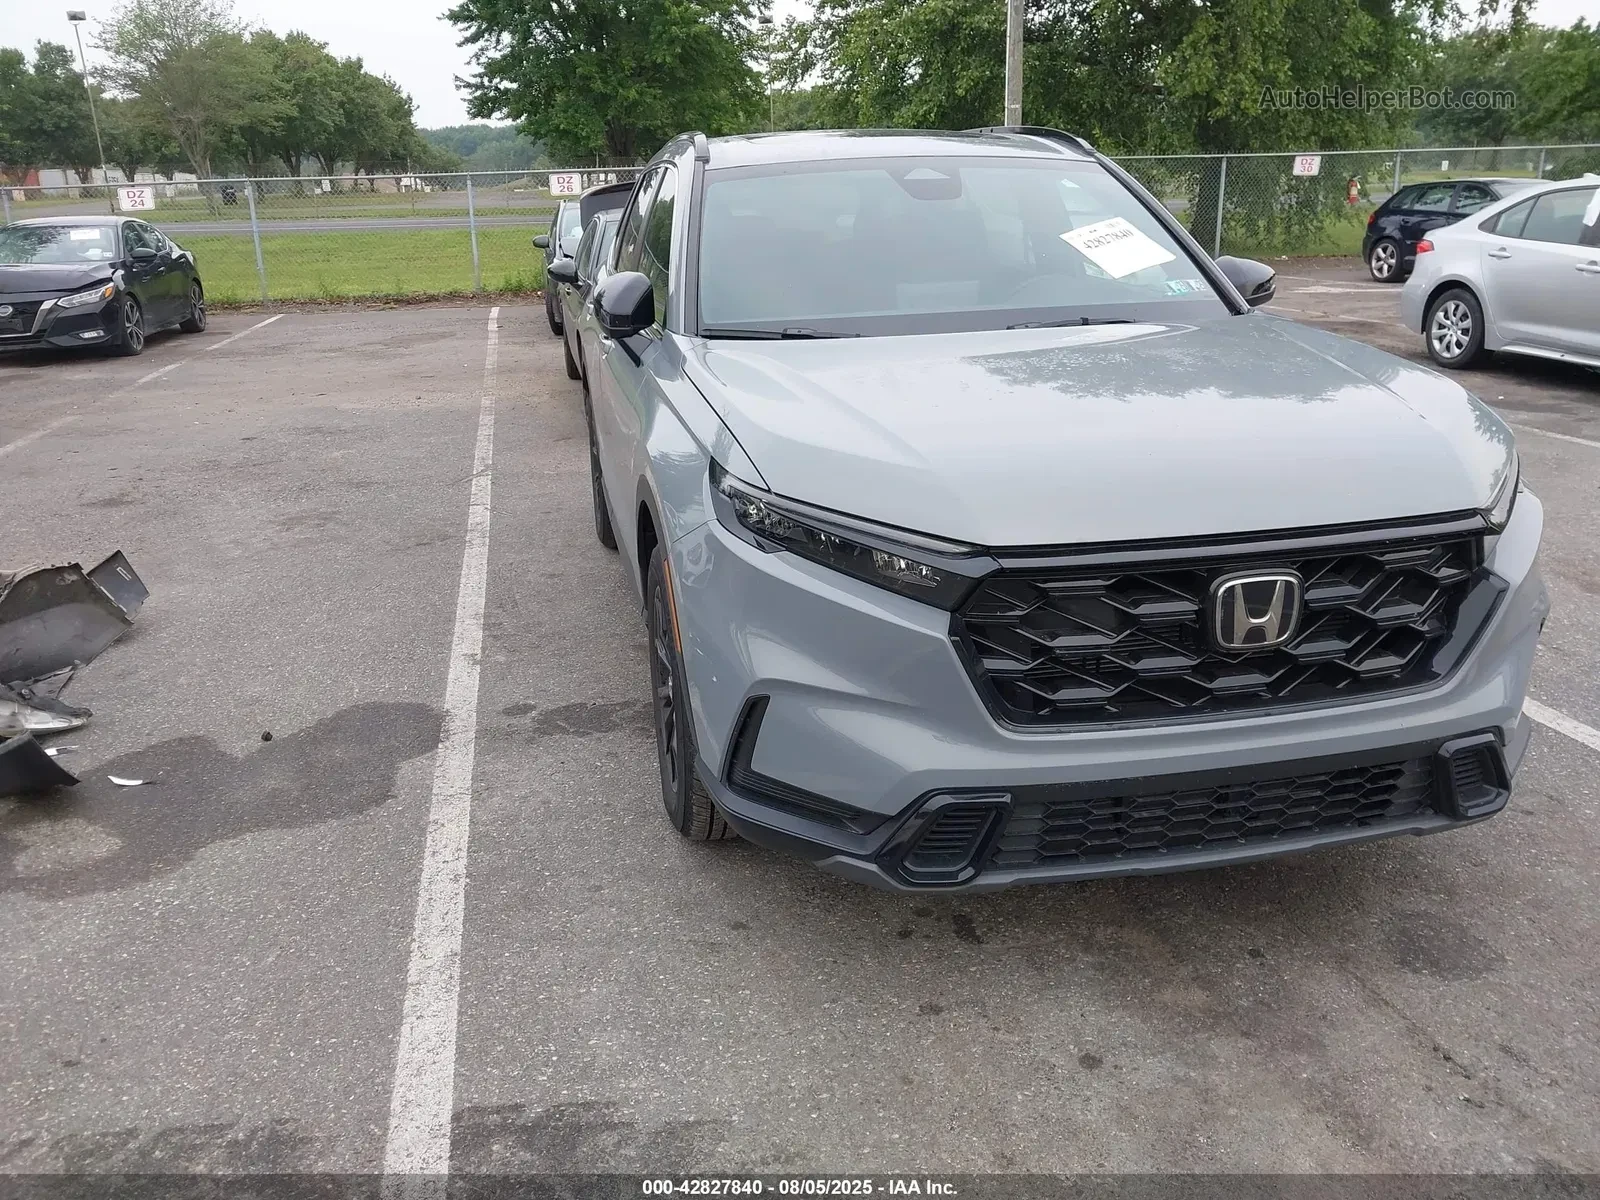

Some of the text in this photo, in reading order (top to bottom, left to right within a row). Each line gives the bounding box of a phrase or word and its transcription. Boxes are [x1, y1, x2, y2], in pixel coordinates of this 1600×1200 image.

[1301, 158, 1315, 166] DZ
[556, 176, 574, 185] DZ
[559, 184, 574, 193] 26
[126, 190, 146, 199] DZ
[130, 199, 145, 208] 24
